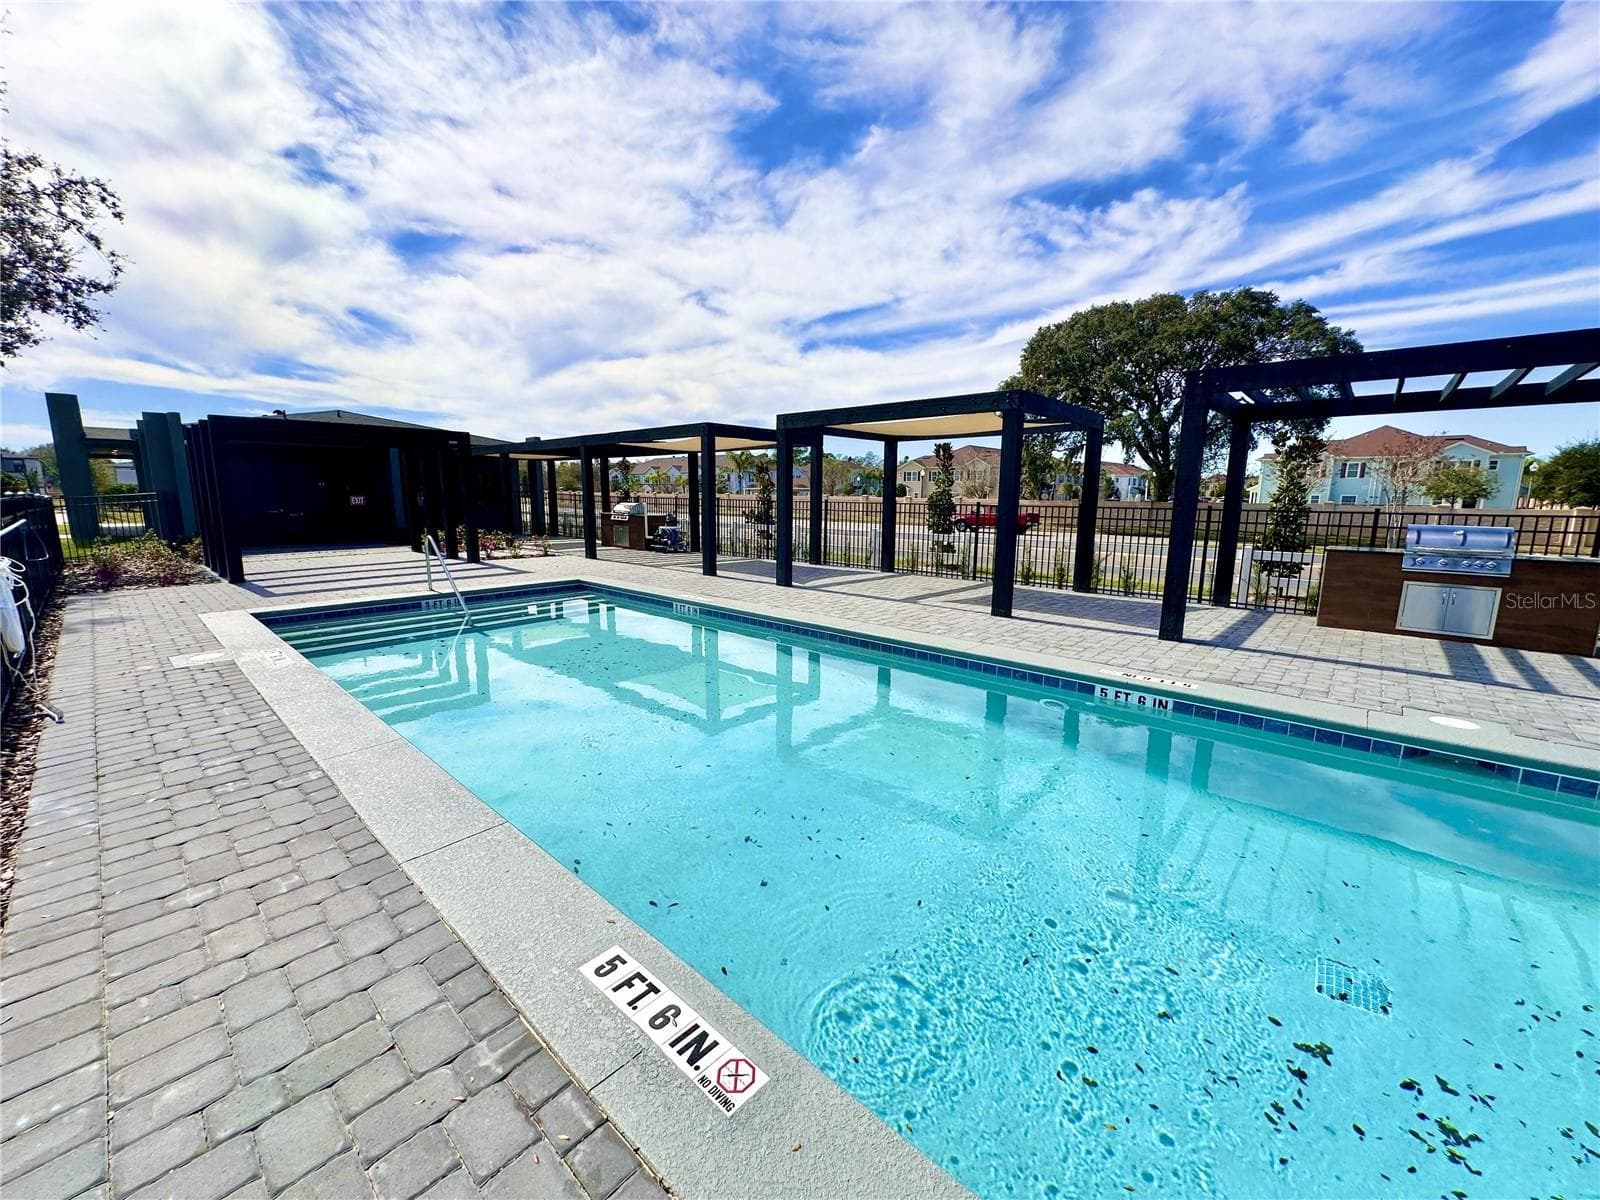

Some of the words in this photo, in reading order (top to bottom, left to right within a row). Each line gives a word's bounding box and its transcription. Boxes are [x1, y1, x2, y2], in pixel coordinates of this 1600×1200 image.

[351, 496, 365, 505] EXIT
[1100, 688, 1108, 698] 5
[1115, 690, 1131, 702] FT
[1138, 695, 1146, 705] 6
[1152, 698, 1168, 710] IN
[594, 954, 627, 977] 5
[612, 971, 661, 1010] FT.
[648, 1004, 682, 1030] 6
[668, 1023, 720, 1071] IN.
[697, 1075, 711, 1089] NO
[708, 1085, 735, 1113] DIVING
